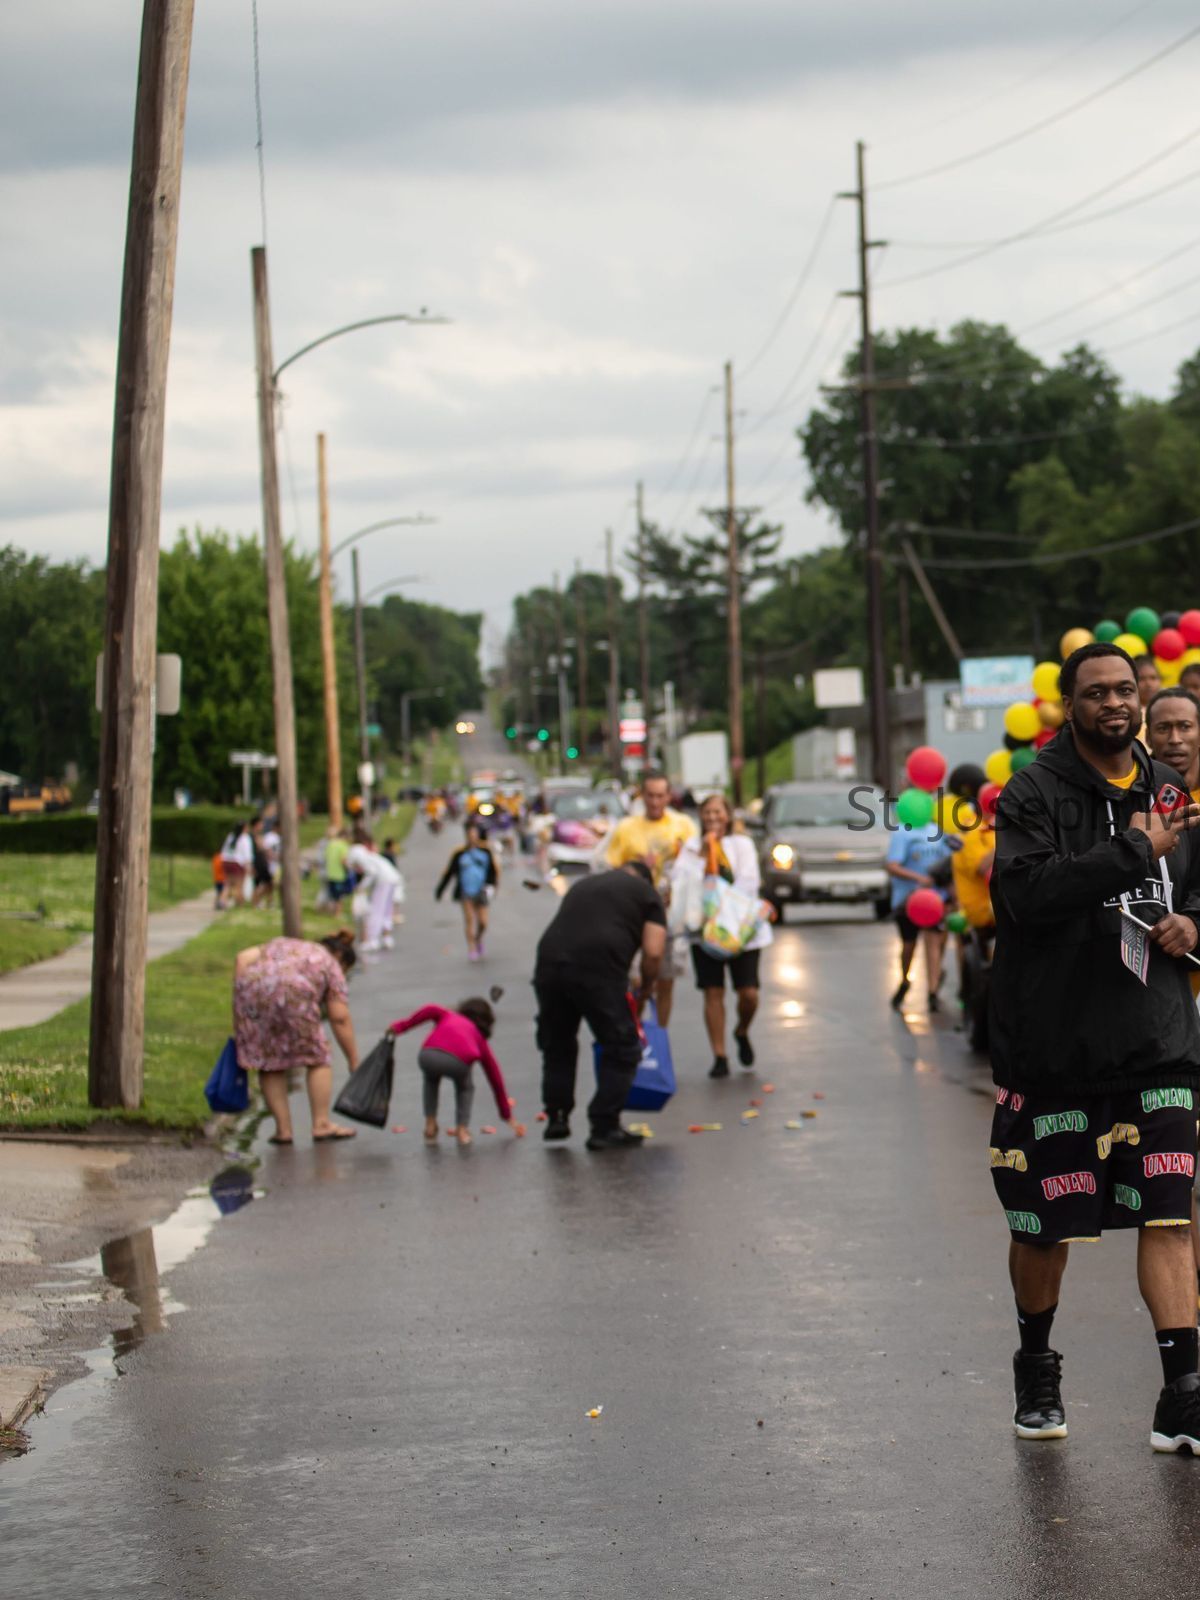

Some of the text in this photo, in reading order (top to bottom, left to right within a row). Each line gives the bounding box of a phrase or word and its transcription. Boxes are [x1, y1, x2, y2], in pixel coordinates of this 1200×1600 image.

[1140, 1087, 1193, 1113] UNLVD
[1032, 1110, 1088, 1140] UNLVD
[1041, 1171, 1096, 1201] UNLVD
